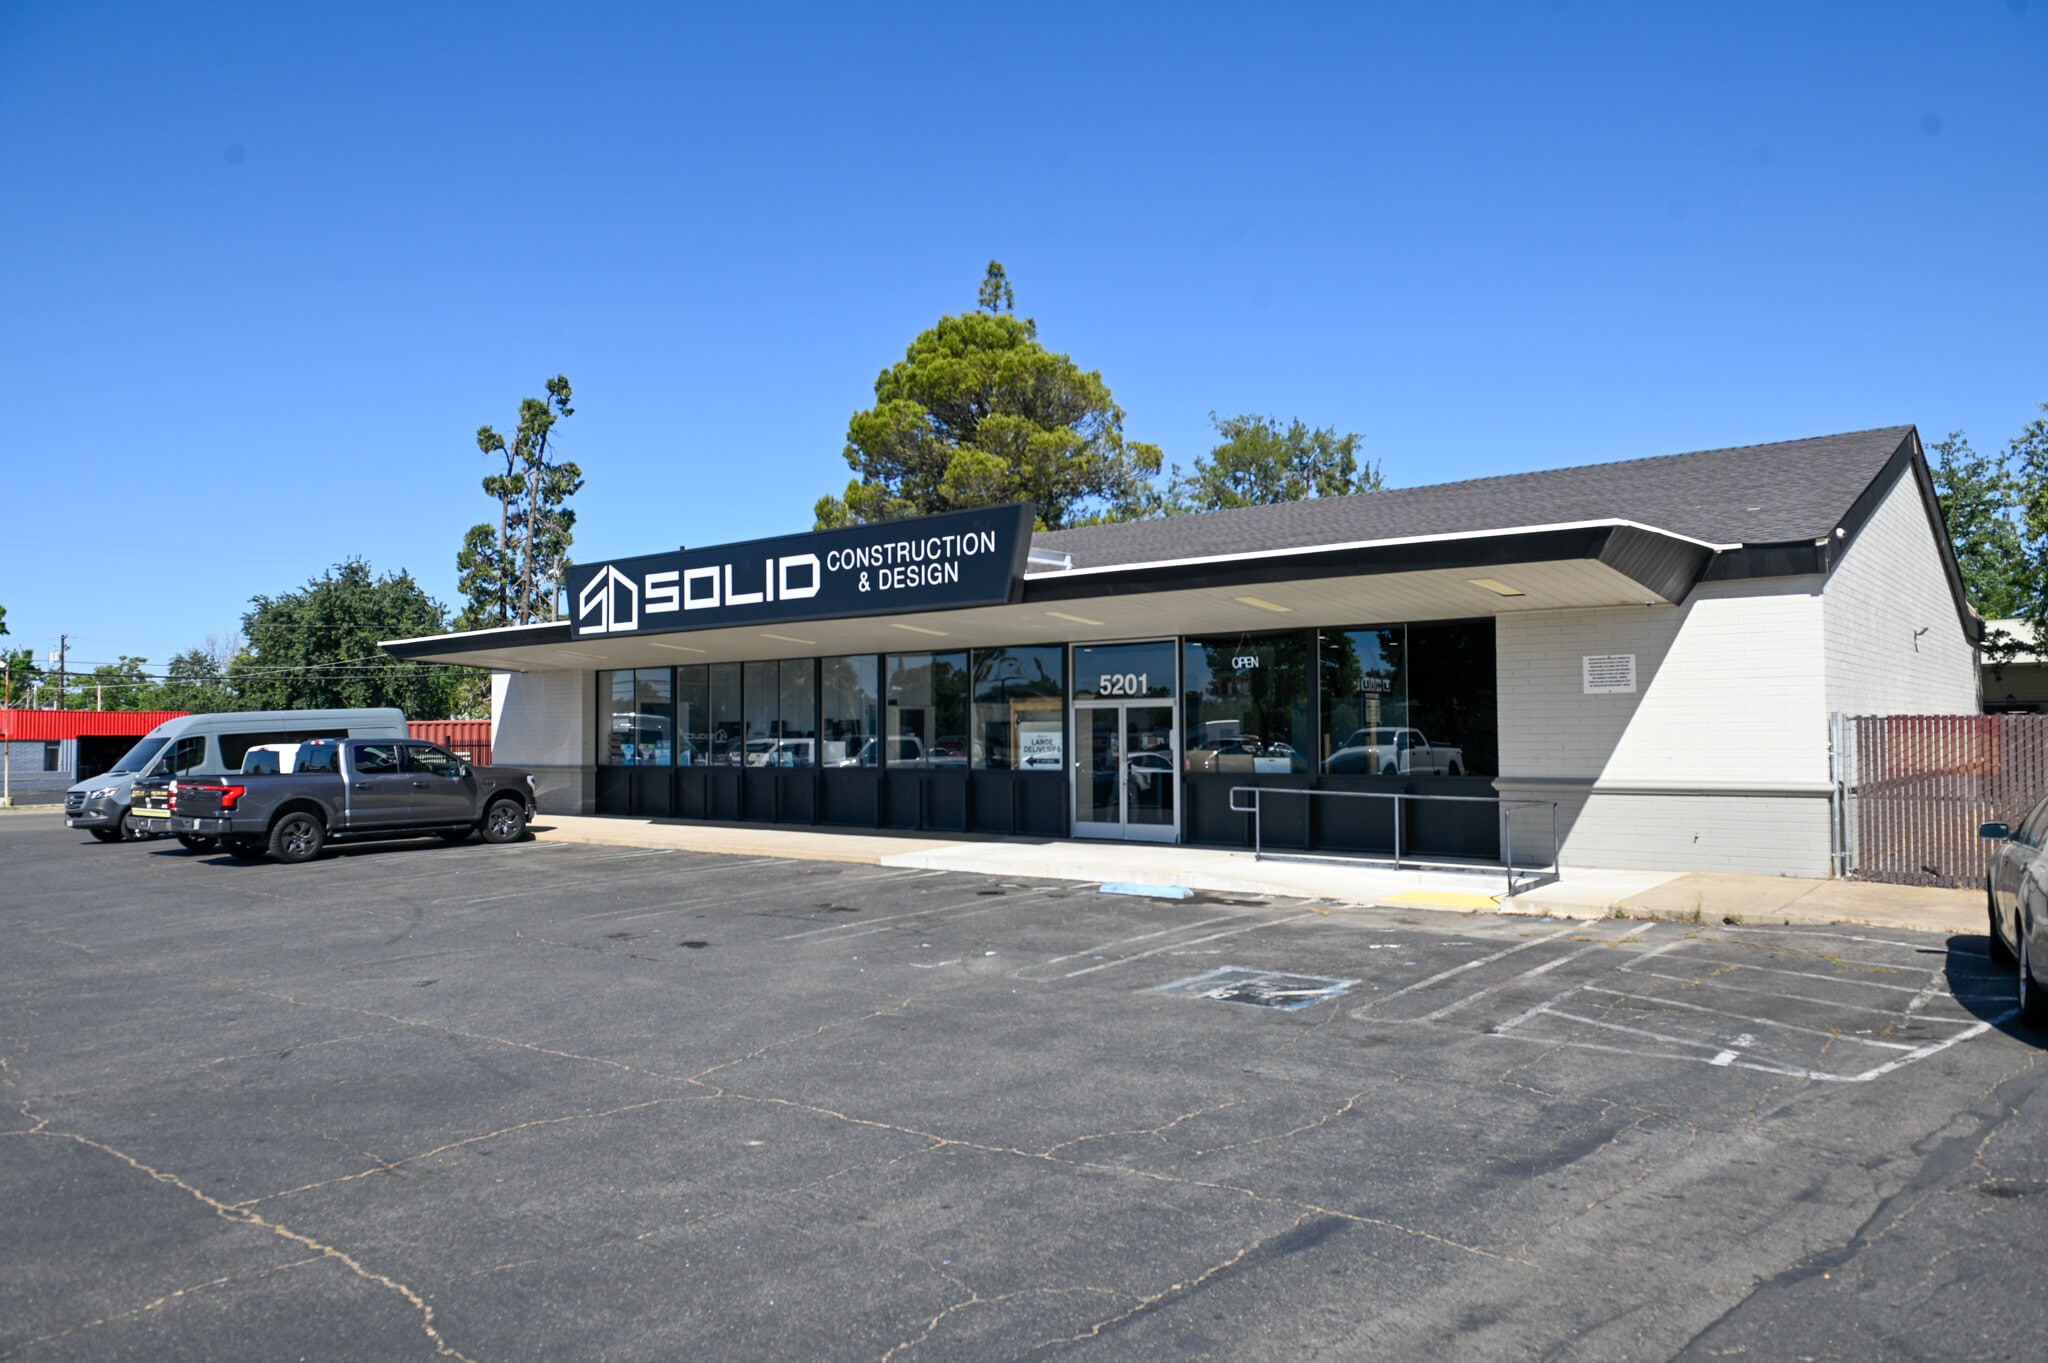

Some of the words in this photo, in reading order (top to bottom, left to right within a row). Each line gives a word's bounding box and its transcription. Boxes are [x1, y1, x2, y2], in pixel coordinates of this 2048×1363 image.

[827, 530, 996, 572] CONSTRUCTION
[645, 553, 821, 614] SOLID
[858, 571, 871, 592] &
[879, 561, 959, 590] DESIGN
[1231, 655, 1260, 669] OPEN
[1099, 673, 1147, 695] 5201
